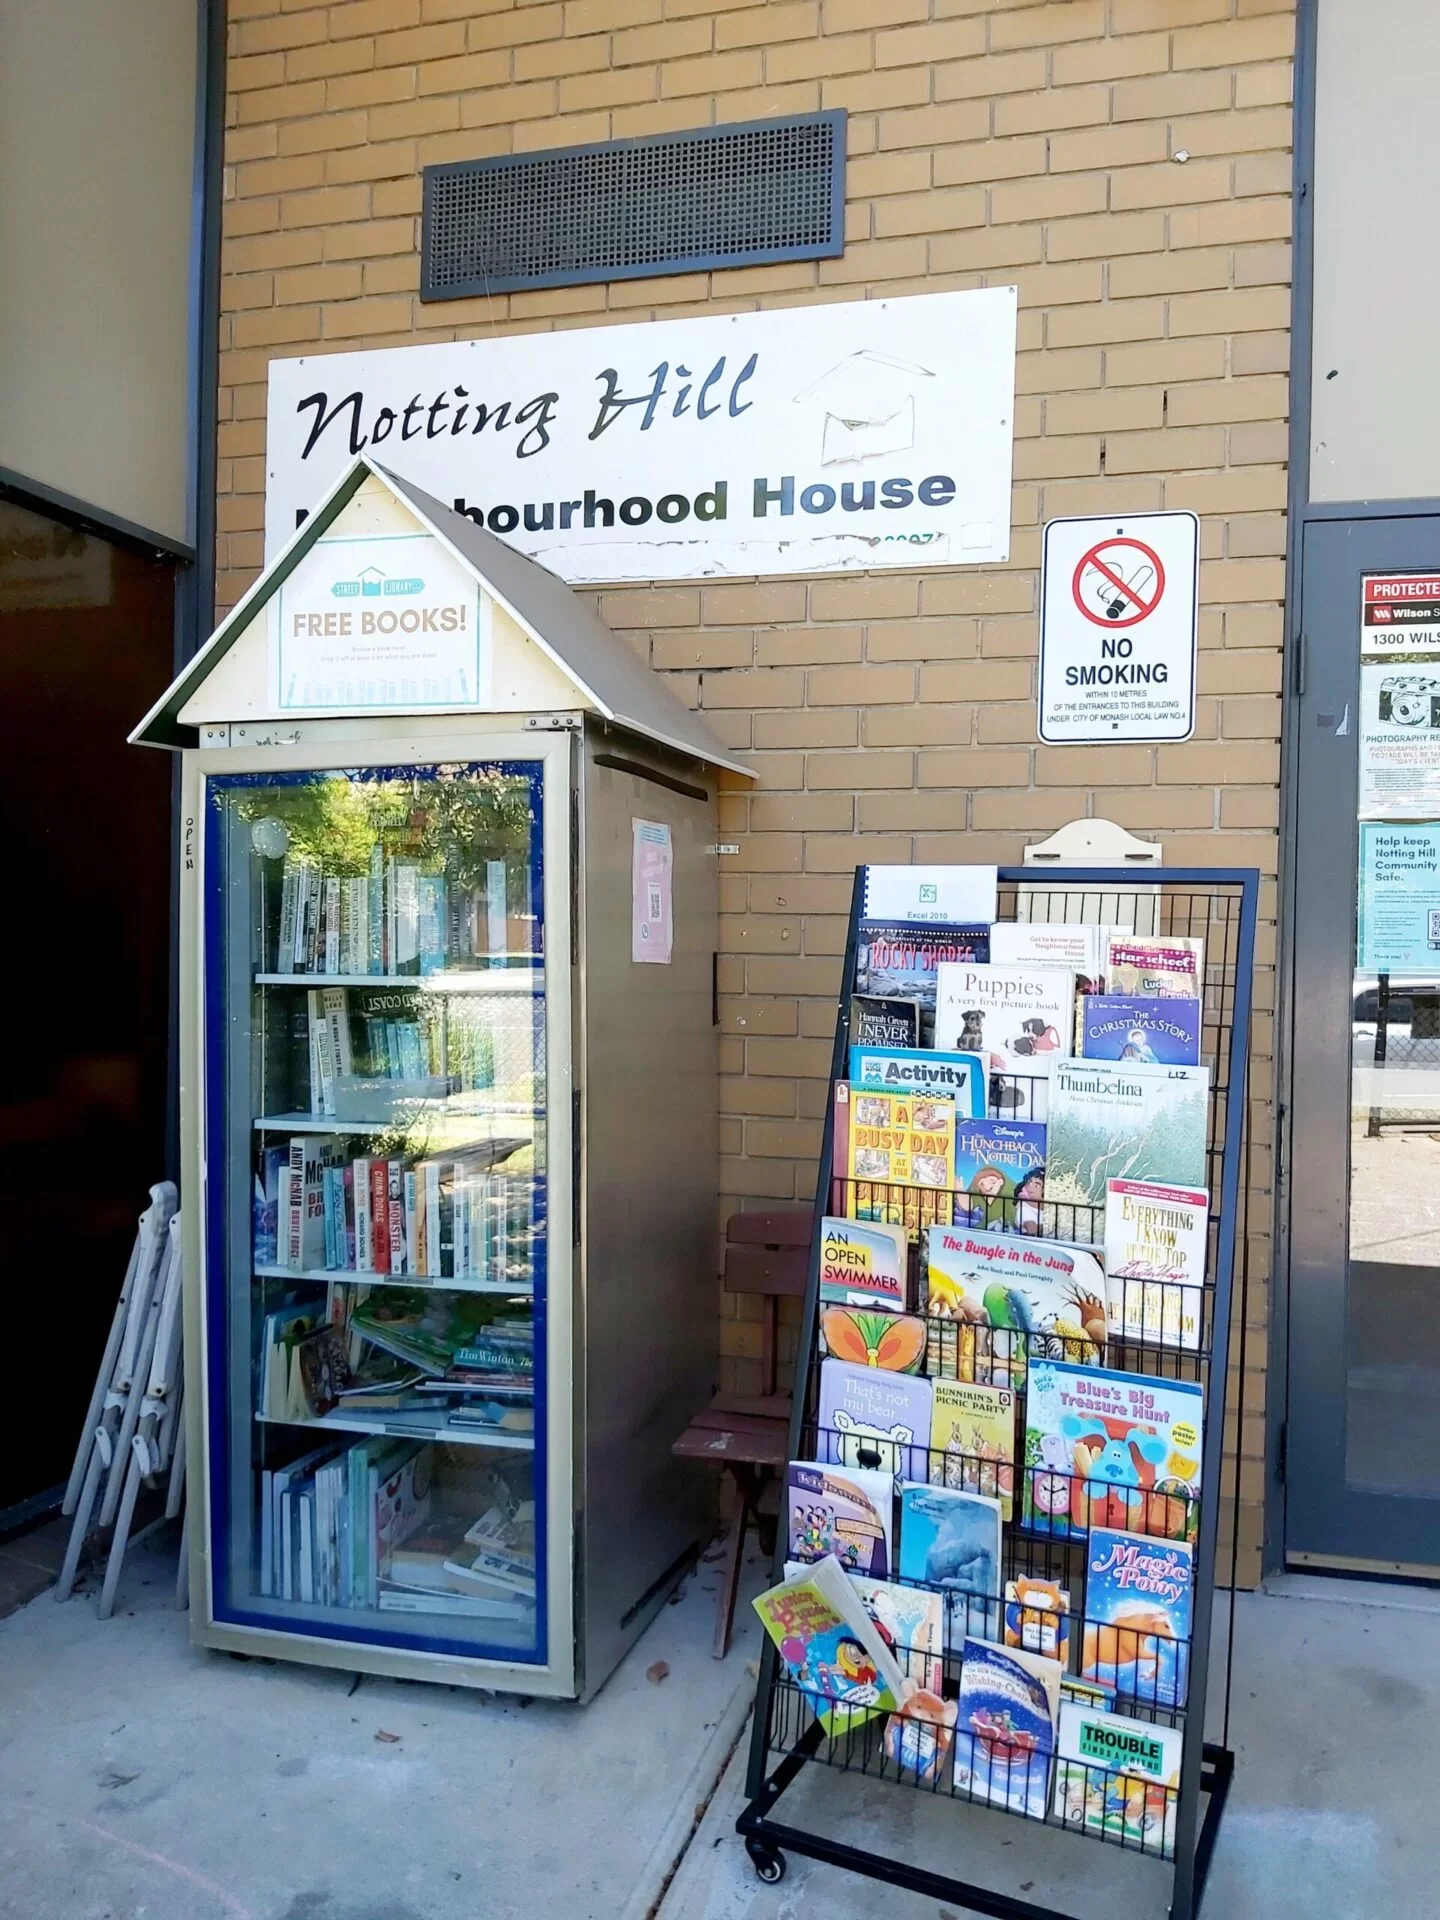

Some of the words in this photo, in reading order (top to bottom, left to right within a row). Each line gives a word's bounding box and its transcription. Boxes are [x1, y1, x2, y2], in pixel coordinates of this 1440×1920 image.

[296, 384, 560, 460] Notting
[588, 353, 759, 441] Hill
[753, 474, 958, 518] House
[293, 612, 353, 637] FREE
[361, 604, 467, 635] BOOKS!
[1393, 608, 1431, 619] Wilson
[1101, 638, 1133, 659] NO
[1373, 633, 1405, 645] 1300
[1065, 663, 1169, 686] SMOKING
[1085, 690, 1109, 699] WITHIN
[1119, 689, 1147, 698] METRES
[1053, 703, 1063, 712] OF
[1064, 703, 1078, 711] THE
[1079, 701, 1119, 711] ENTRANCES
[1120, 701, 1129, 709] TO
[1130, 701, 1146, 709] THIS
[1147, 700, 1179, 709] BUILDING
[1047, 715, 1070, 723] UNDER
[1072, 714, 1089, 722] CITY
[1100, 713, 1130, 721] MONASH
[1130, 713, 1152, 721] LOCAL
[1153, 712, 1168, 720] LAW
[1366, 734, 1428, 743] PHOTOGRAPHY
[186, 817, 194, 870] OPEN
[1376, 837, 1400, 849] Help
[1403, 836, 1431, 848] keep
[1376, 849, 1415, 860] Notting
[1418, 848, 1436, 858] Hill
[1375, 861, 1438, 871] Community
[1375, 872, 1404, 882] Safe.
[907, 911, 928, 920] Excel
[929, 912, 948, 920] 2010
[871, 942, 917, 973] ROCKY
[1035, 943, 1085, 951] Neighbourhood
[1115, 951, 1144, 963] star
[1146, 953, 1191, 968] school
[964, 973, 1044, 999] Puppies
[947, 995, 954, 1004] A
[957, 997, 977, 1007] very
[979, 997, 998, 1007] first
[1001, 999, 1033, 1010] picture
[1036, 1001, 1060, 1011] book
[858, 1012, 887, 1023] Hannah
[887, 1014, 909, 1026] Green
[864, 1025, 909, 1042] NEVER
[1089, 1019, 1156, 1040] CHRISTMAS
[1157, 1020, 1193, 1044] STORY
[885, 1062, 967, 1089] Activity
[1167, 1069, 1190, 1080] LIZ
[1057, 1074, 1143, 1097] Thumbelina
[896, 1106, 909, 1124] A
[855, 1127, 907, 1150] BUSY
[909, 1133, 949, 1156] DAY
[960, 1136, 1040, 1155] HUNCHBACK
[291, 1146, 304, 1174] ANDY
[895, 1157, 907, 1167] AT
[975, 1151, 1017, 1166] NOTRE
[374, 1170, 384, 1195] CHINA
[892, 1168, 908, 1177] THE
[855, 1182, 948, 1211] BUILDING
[375, 1197, 385, 1223] DOLLS
[904, 1208, 947, 1230] SITE
[1122, 1196, 1194, 1231] EVERYTHING
[389, 1202, 400, 1253] MONSTER
[1143, 1223, 1179, 1248] KNOW
[825, 1231, 849, 1246] AN
[825, 1247, 866, 1267] OPEN
[942, 1235, 963, 1253] The
[965, 1240, 1006, 1262] Bungle
[1008, 1246, 1020, 1261] in
[1022, 1250, 1042, 1266] the
[1166, 1247, 1187, 1268] TOP
[824, 1264, 898, 1292] SWIMMER
[459, 1348, 478, 1360] Tim
[479, 1350, 514, 1365] Winton
[519, 1357, 534, 1367] The
[843, 1378, 882, 1400] That's
[886, 1392, 910, 1408] not
[935, 1386, 993, 1403] BUNNIKIN'S
[1076, 1381, 1121, 1401] Blue's
[1128, 1390, 1155, 1408] Big
[843, 1398, 864, 1415] my
[935, 1395, 971, 1408] PICNIC
[972, 1401, 1007, 1415] PARTY
[1060, 1392, 1128, 1416] Treasure
[1132, 1405, 1170, 1424] Hunt
[1172, 1430, 1196, 1441] poster
[1091, 1543, 1189, 1582] Magic
[1113, 1565, 1184, 1605] Pony
[1084, 1725, 1160, 1760] TROUBLE
[1082, 1742, 1112, 1758] FINDS
[1114, 1751, 1120, 1760] A
[1122, 1754, 1159, 1771] FRIEND
